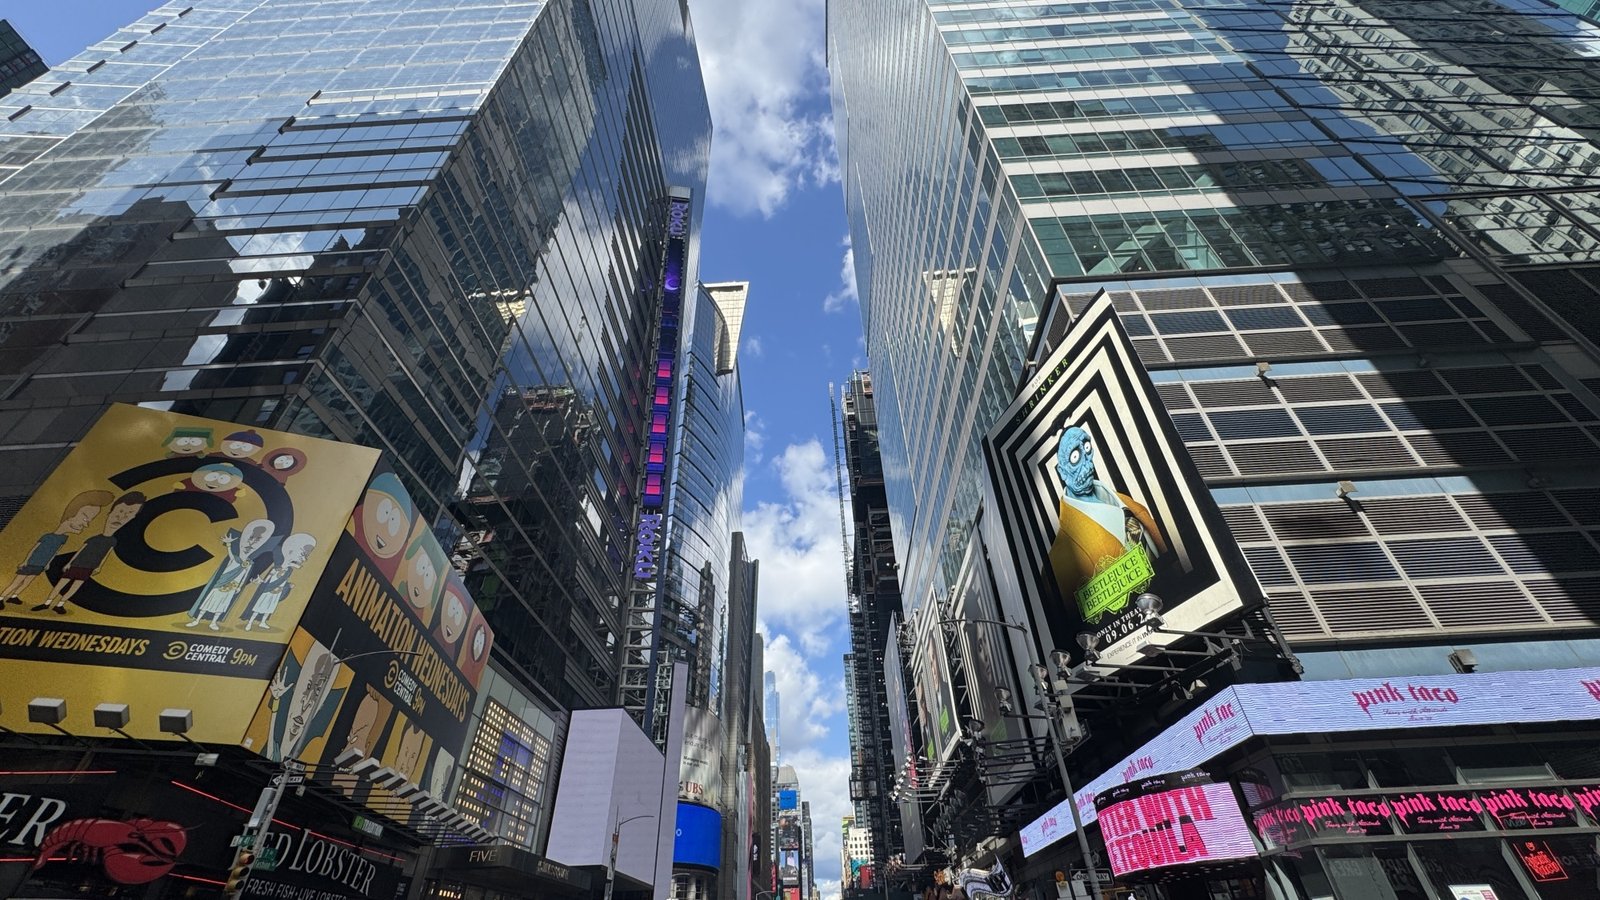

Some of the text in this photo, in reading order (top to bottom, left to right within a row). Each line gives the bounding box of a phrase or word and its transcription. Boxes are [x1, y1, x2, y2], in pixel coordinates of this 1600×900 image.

[1016, 358, 1068, 425] SHRINKER
[1083, 555, 1139, 601] BEETLEJUICE
[1086, 566, 1143, 612] BEETLEJUICE
[39, 630, 150, 656] WEDNESDAYS
[335, 558, 470, 723] ANIMATION WEDNESDAYS
[1097, 624, 1112, 638] ONLY
[1112, 619, 1121, 628] IN
[1105, 613, 1147, 644] 09.06.2
[185, 648, 258, 666] CENTRAL 9PM
[189, 643, 233, 655] COMEDY
[1107, 641, 1132, 659] EXPERIENCE
[398, 669, 418, 694] COMEDY
[394, 681, 426, 717] CENTRAL 9PM
[1352, 682, 1459, 720] pink taco
[1193, 709, 1217, 750] pink
[1122, 755, 1154, 782] pink taco
[1180, 772, 1195, 782] pink
[685, 782, 704, 795] UBS
[1141, 780, 1153, 790] pink
[1138, 785, 1214, 829] WITH
[1300, 797, 1391, 833] pink taco
[1391, 792, 1483, 829] pink taco
[1481, 788, 1575, 819] pink taco
[0, 792, 66, 847] ER
[289, 828, 376, 896] LOBSTER
[468, 849, 498, 862] FIVE
[1115, 822, 1209, 872] TEQUILA
[245, 878, 277, 896] FRESH
[276, 883, 295, 898] FISH
[298, 888, 317, 900] LIVE
